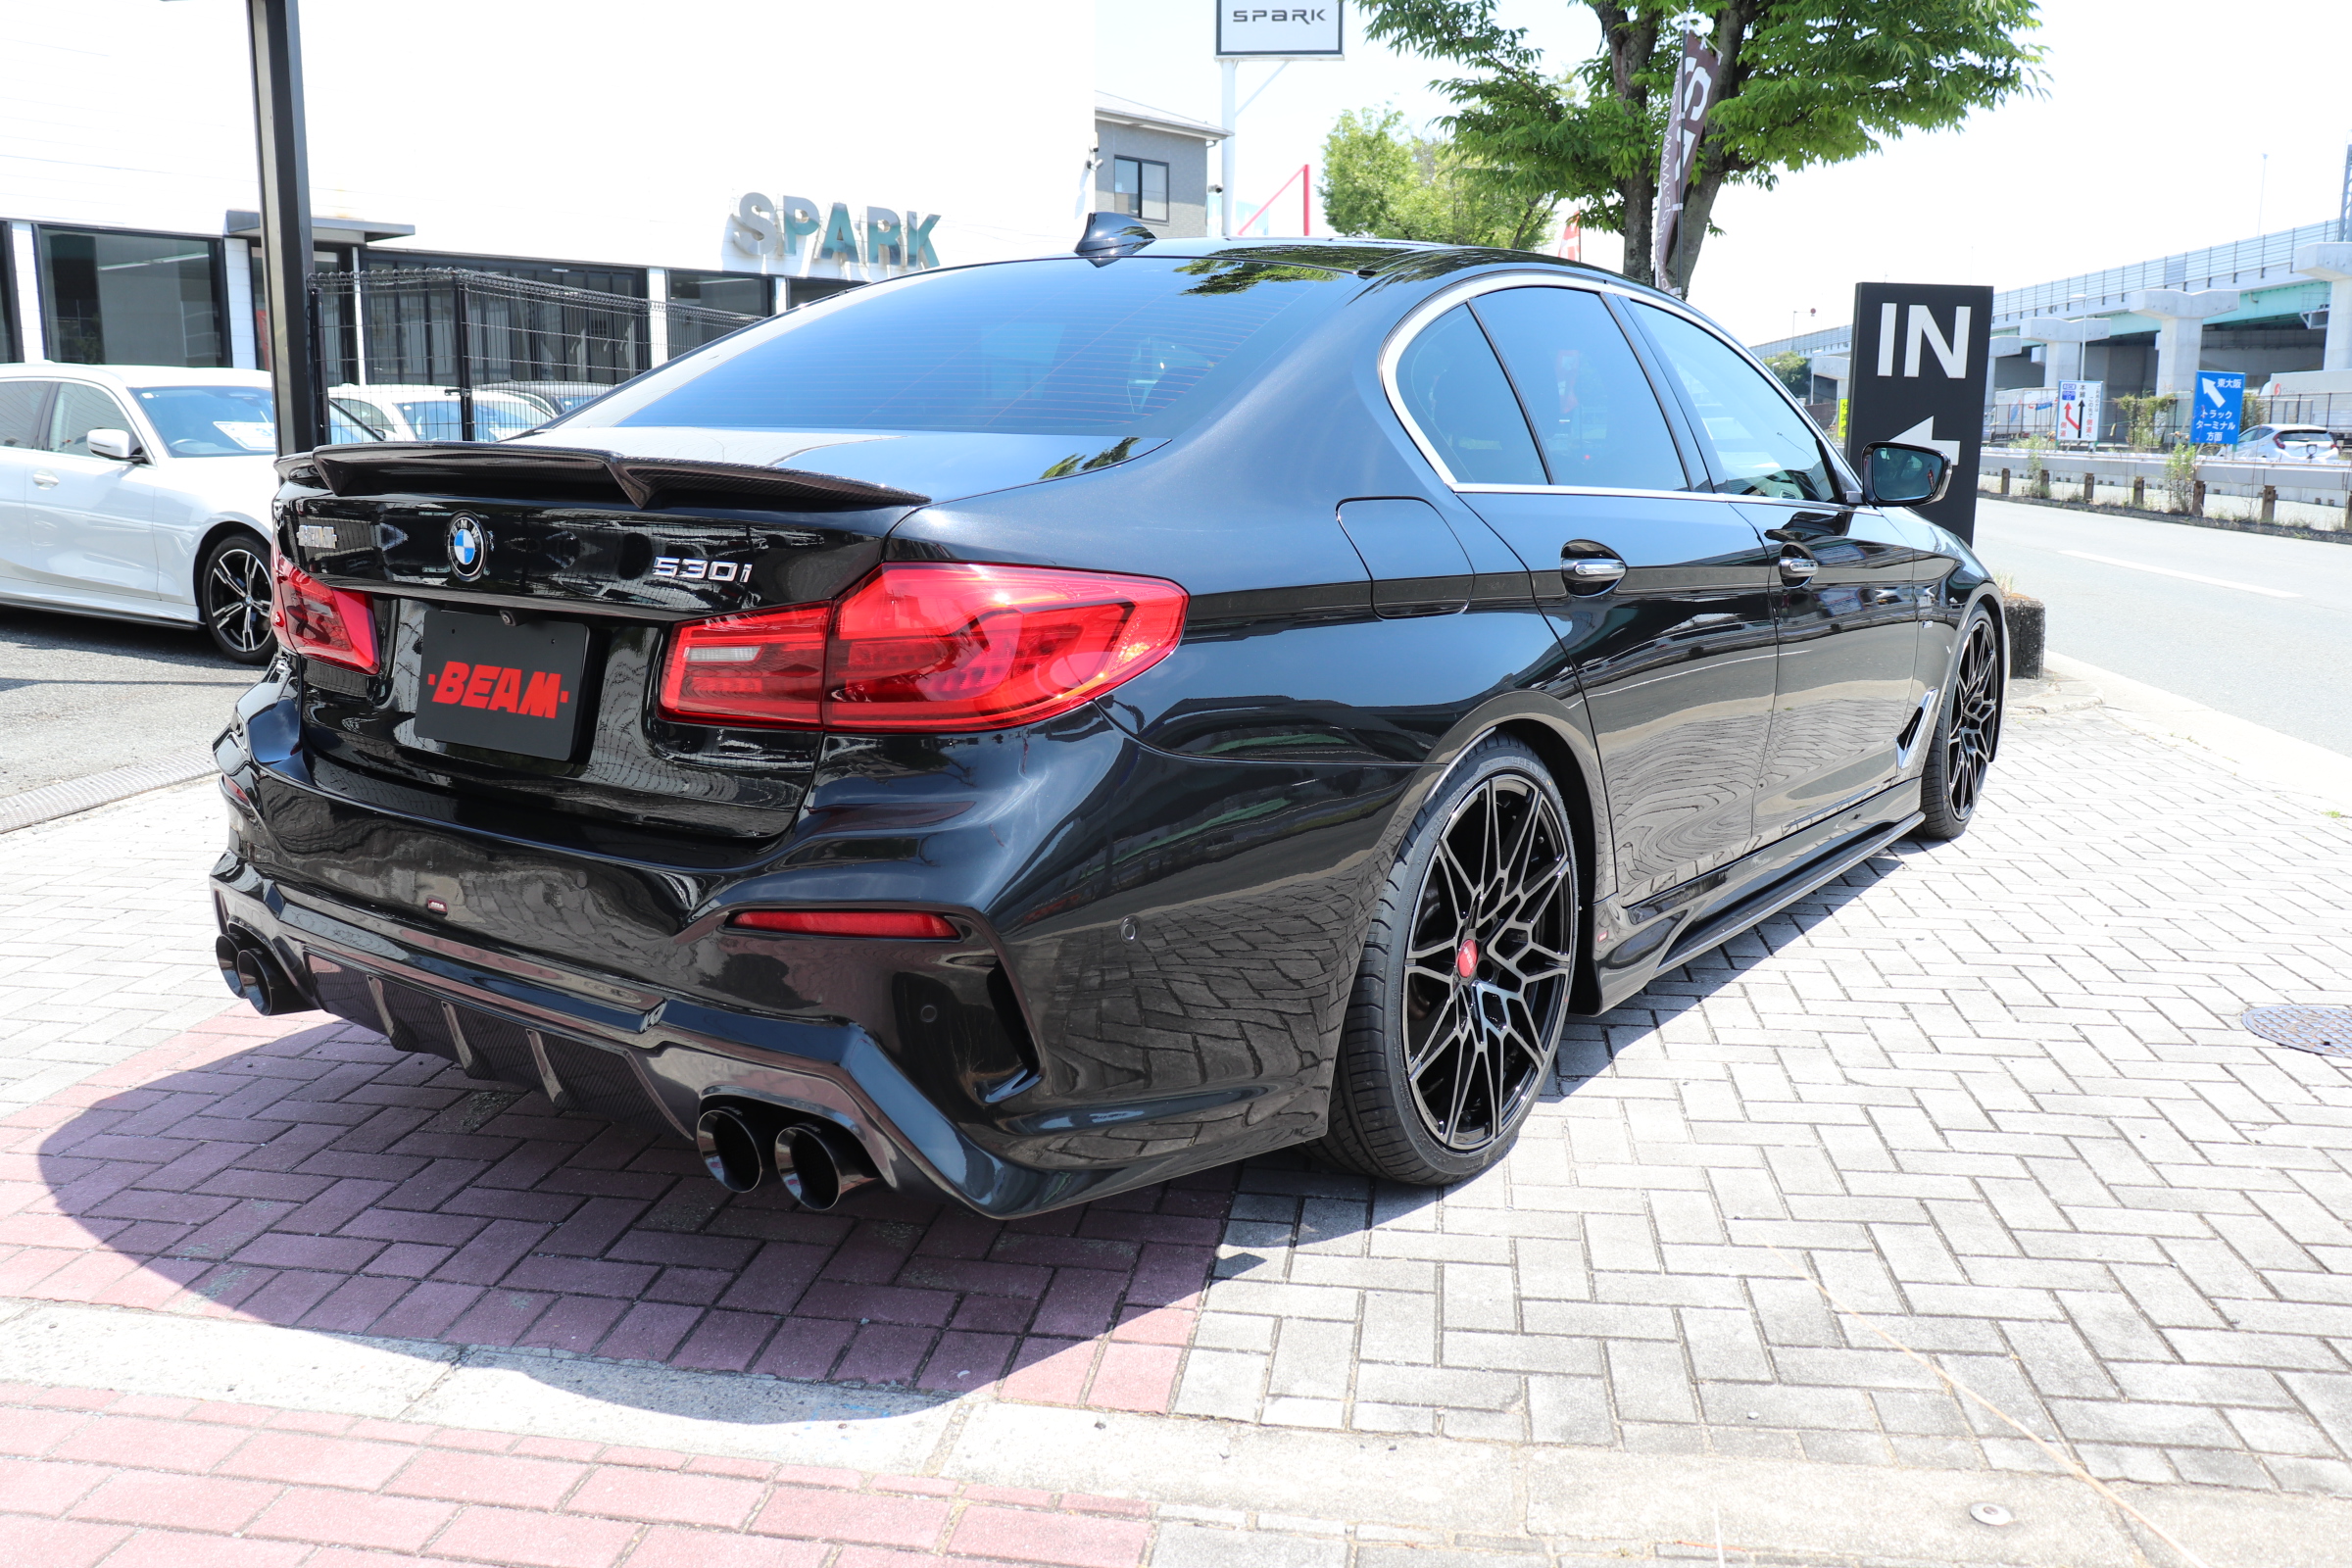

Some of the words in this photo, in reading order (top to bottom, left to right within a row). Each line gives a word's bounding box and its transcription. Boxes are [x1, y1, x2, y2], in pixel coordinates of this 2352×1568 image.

[738, 192, 941, 268] SPARK
[1877, 302, 1972, 379] IN
[2217, 377, 2243, 389] 東大阪
[2201, 409, 2233, 420] トラック
[2195, 420, 2236, 431] ターミナル
[2205, 432, 2224, 443] 方面
[652, 556, 754, 583] 530i
[431, 661, 562, 719] BEAM
